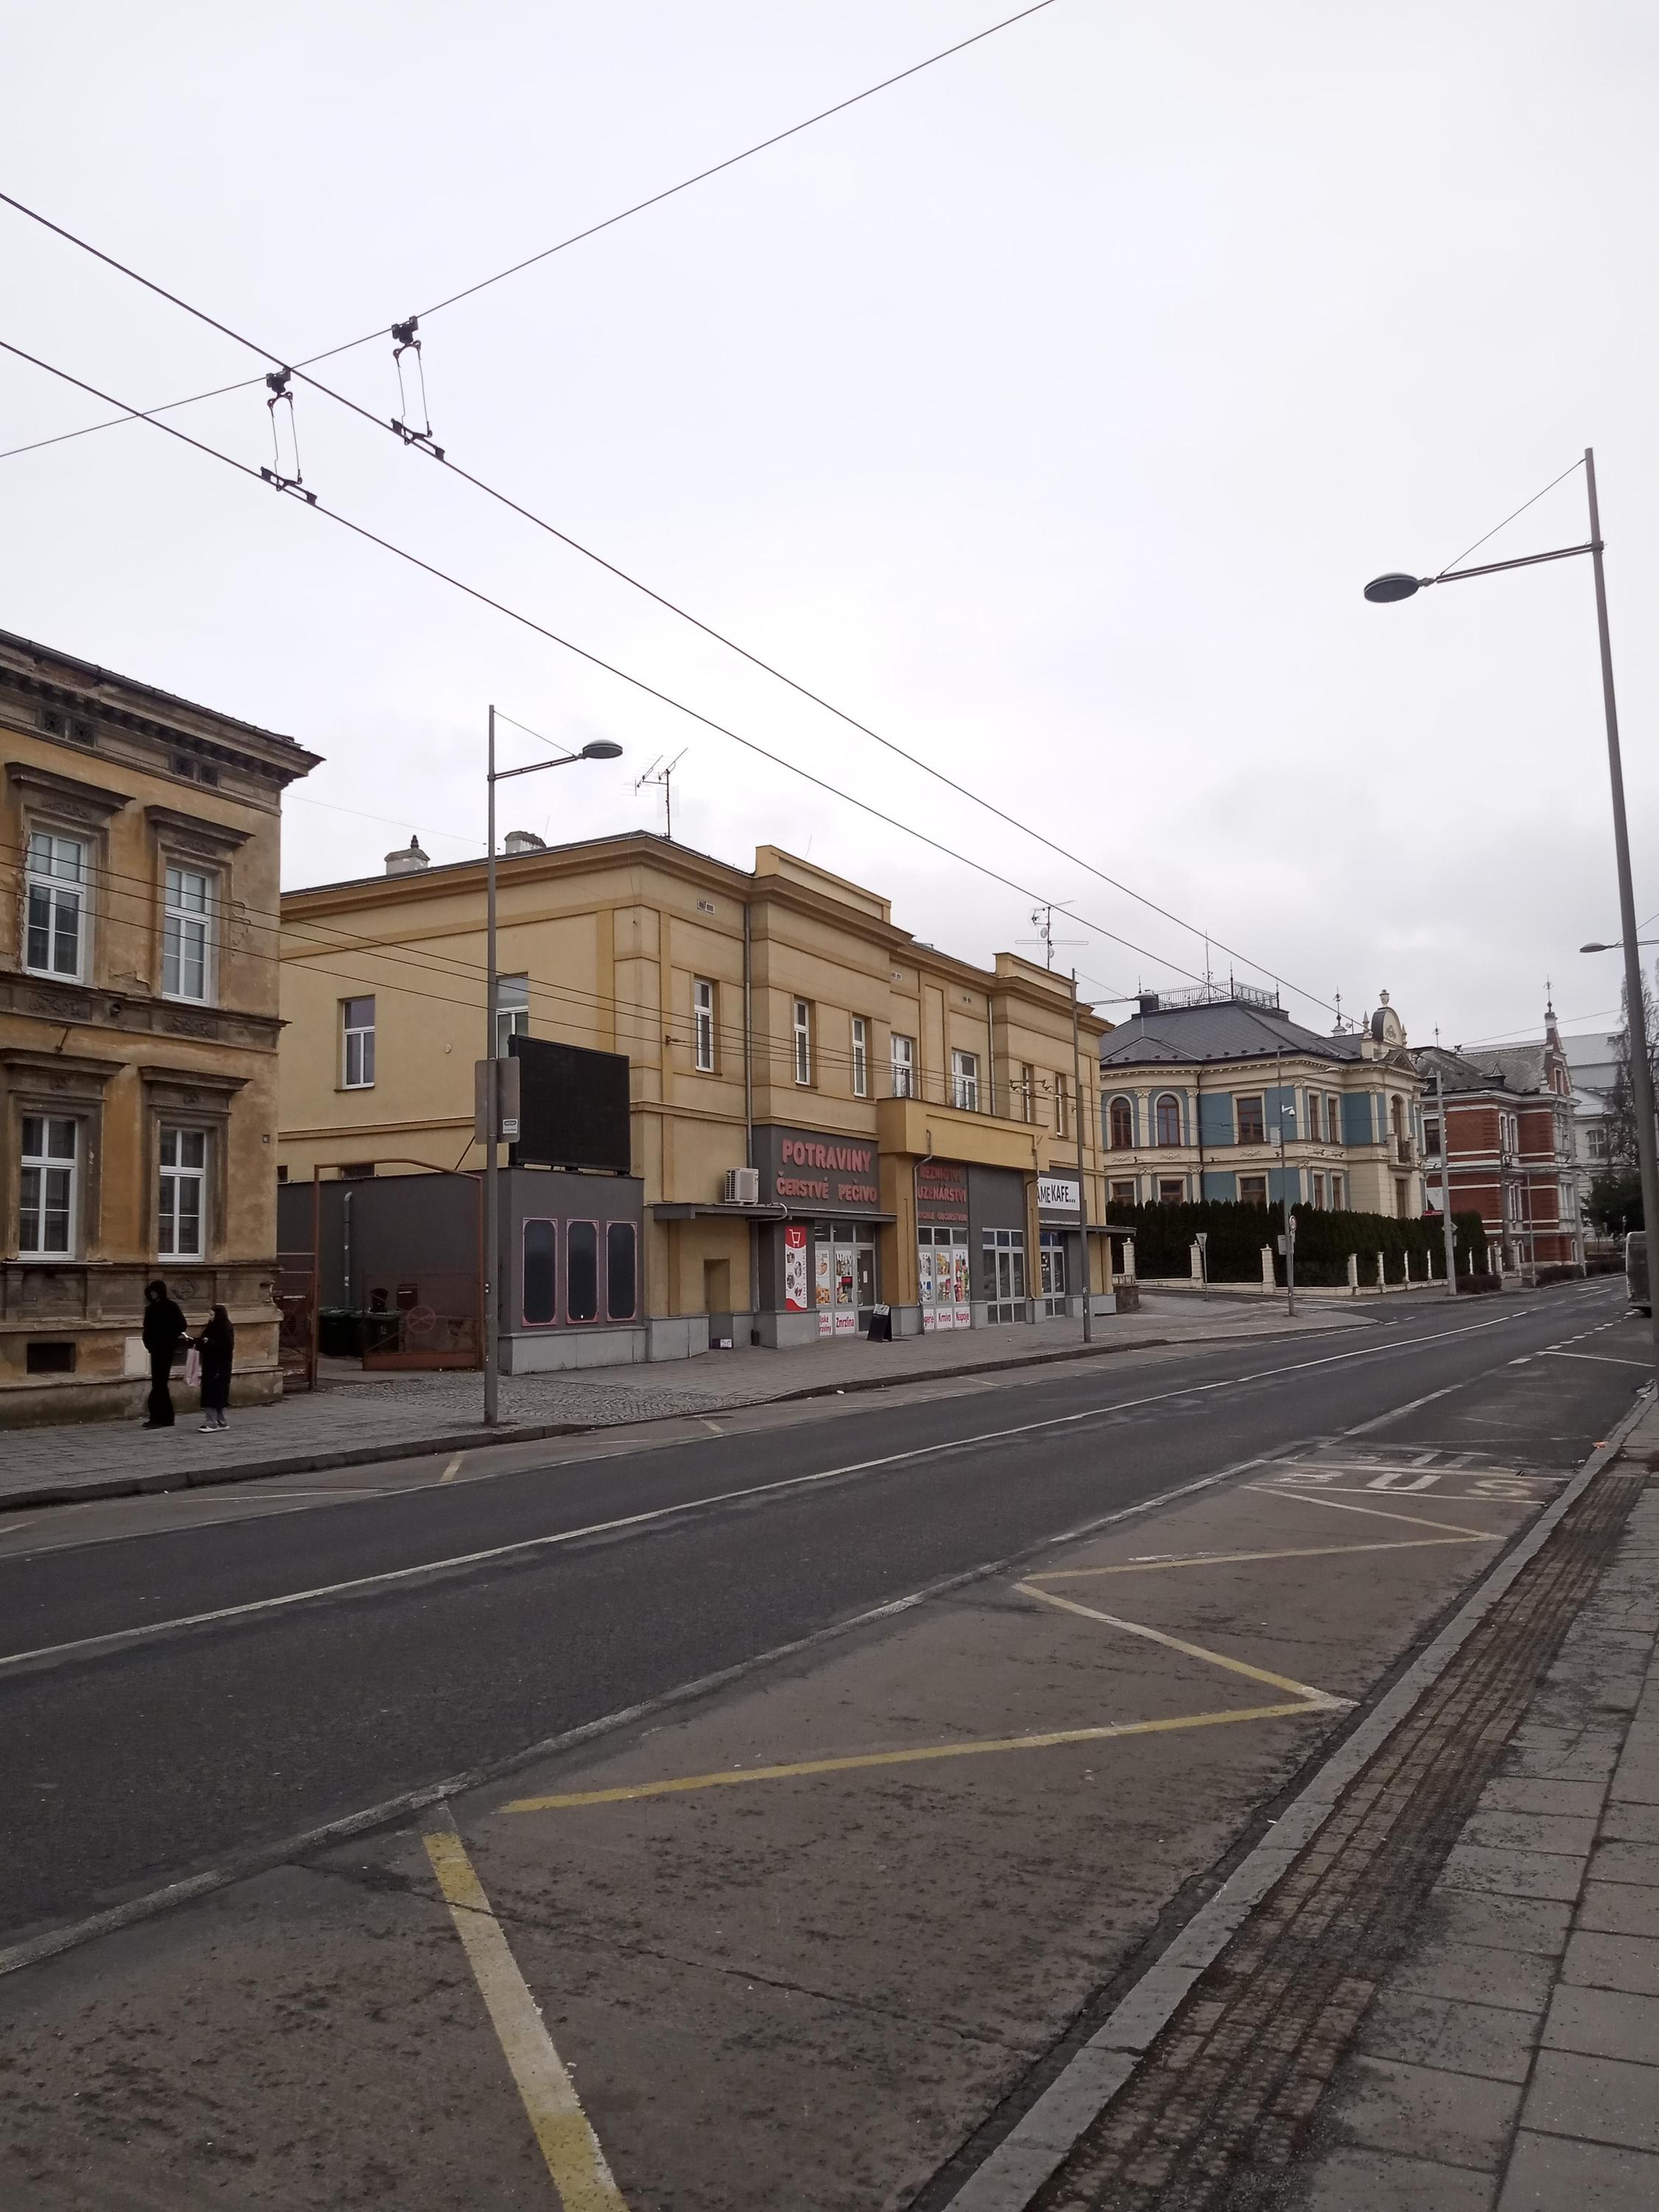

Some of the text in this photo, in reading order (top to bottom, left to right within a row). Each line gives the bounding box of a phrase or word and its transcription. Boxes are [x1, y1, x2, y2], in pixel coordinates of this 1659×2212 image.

[782, 1139, 872, 1173] POTRAVINY
[776, 1171, 878, 1203] ČERSTVÉ PEČIVO
